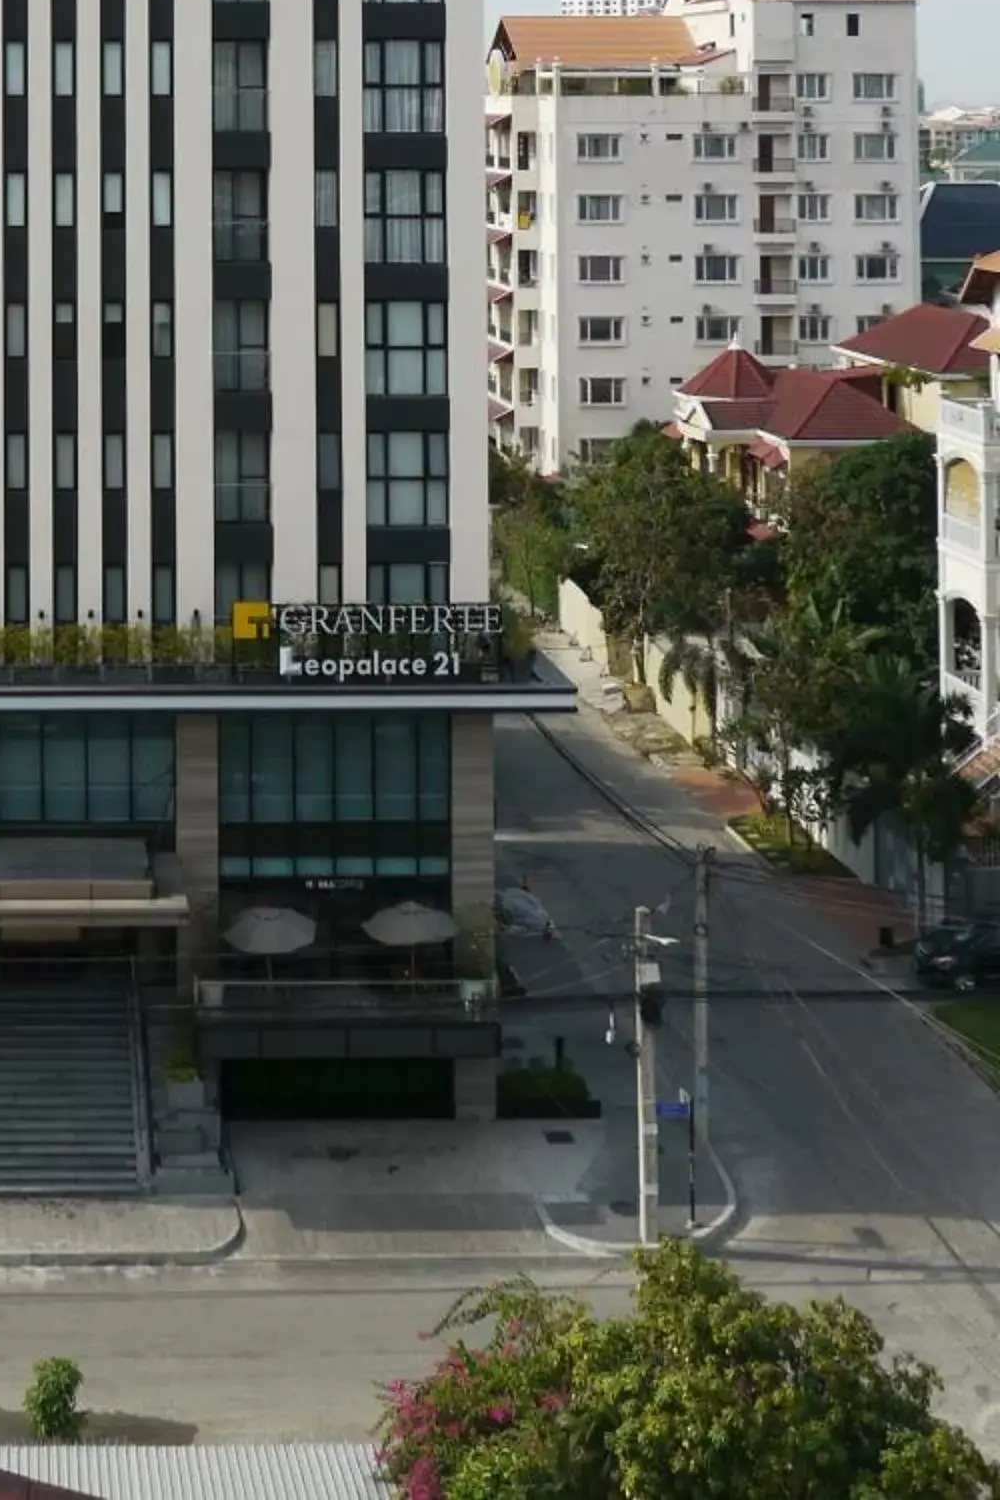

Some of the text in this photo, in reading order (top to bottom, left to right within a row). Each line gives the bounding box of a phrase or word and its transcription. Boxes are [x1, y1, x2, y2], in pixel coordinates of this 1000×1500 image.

[279, 604, 503, 634] GRANFERTE
[279, 646, 460, 682] Leopalace 21
